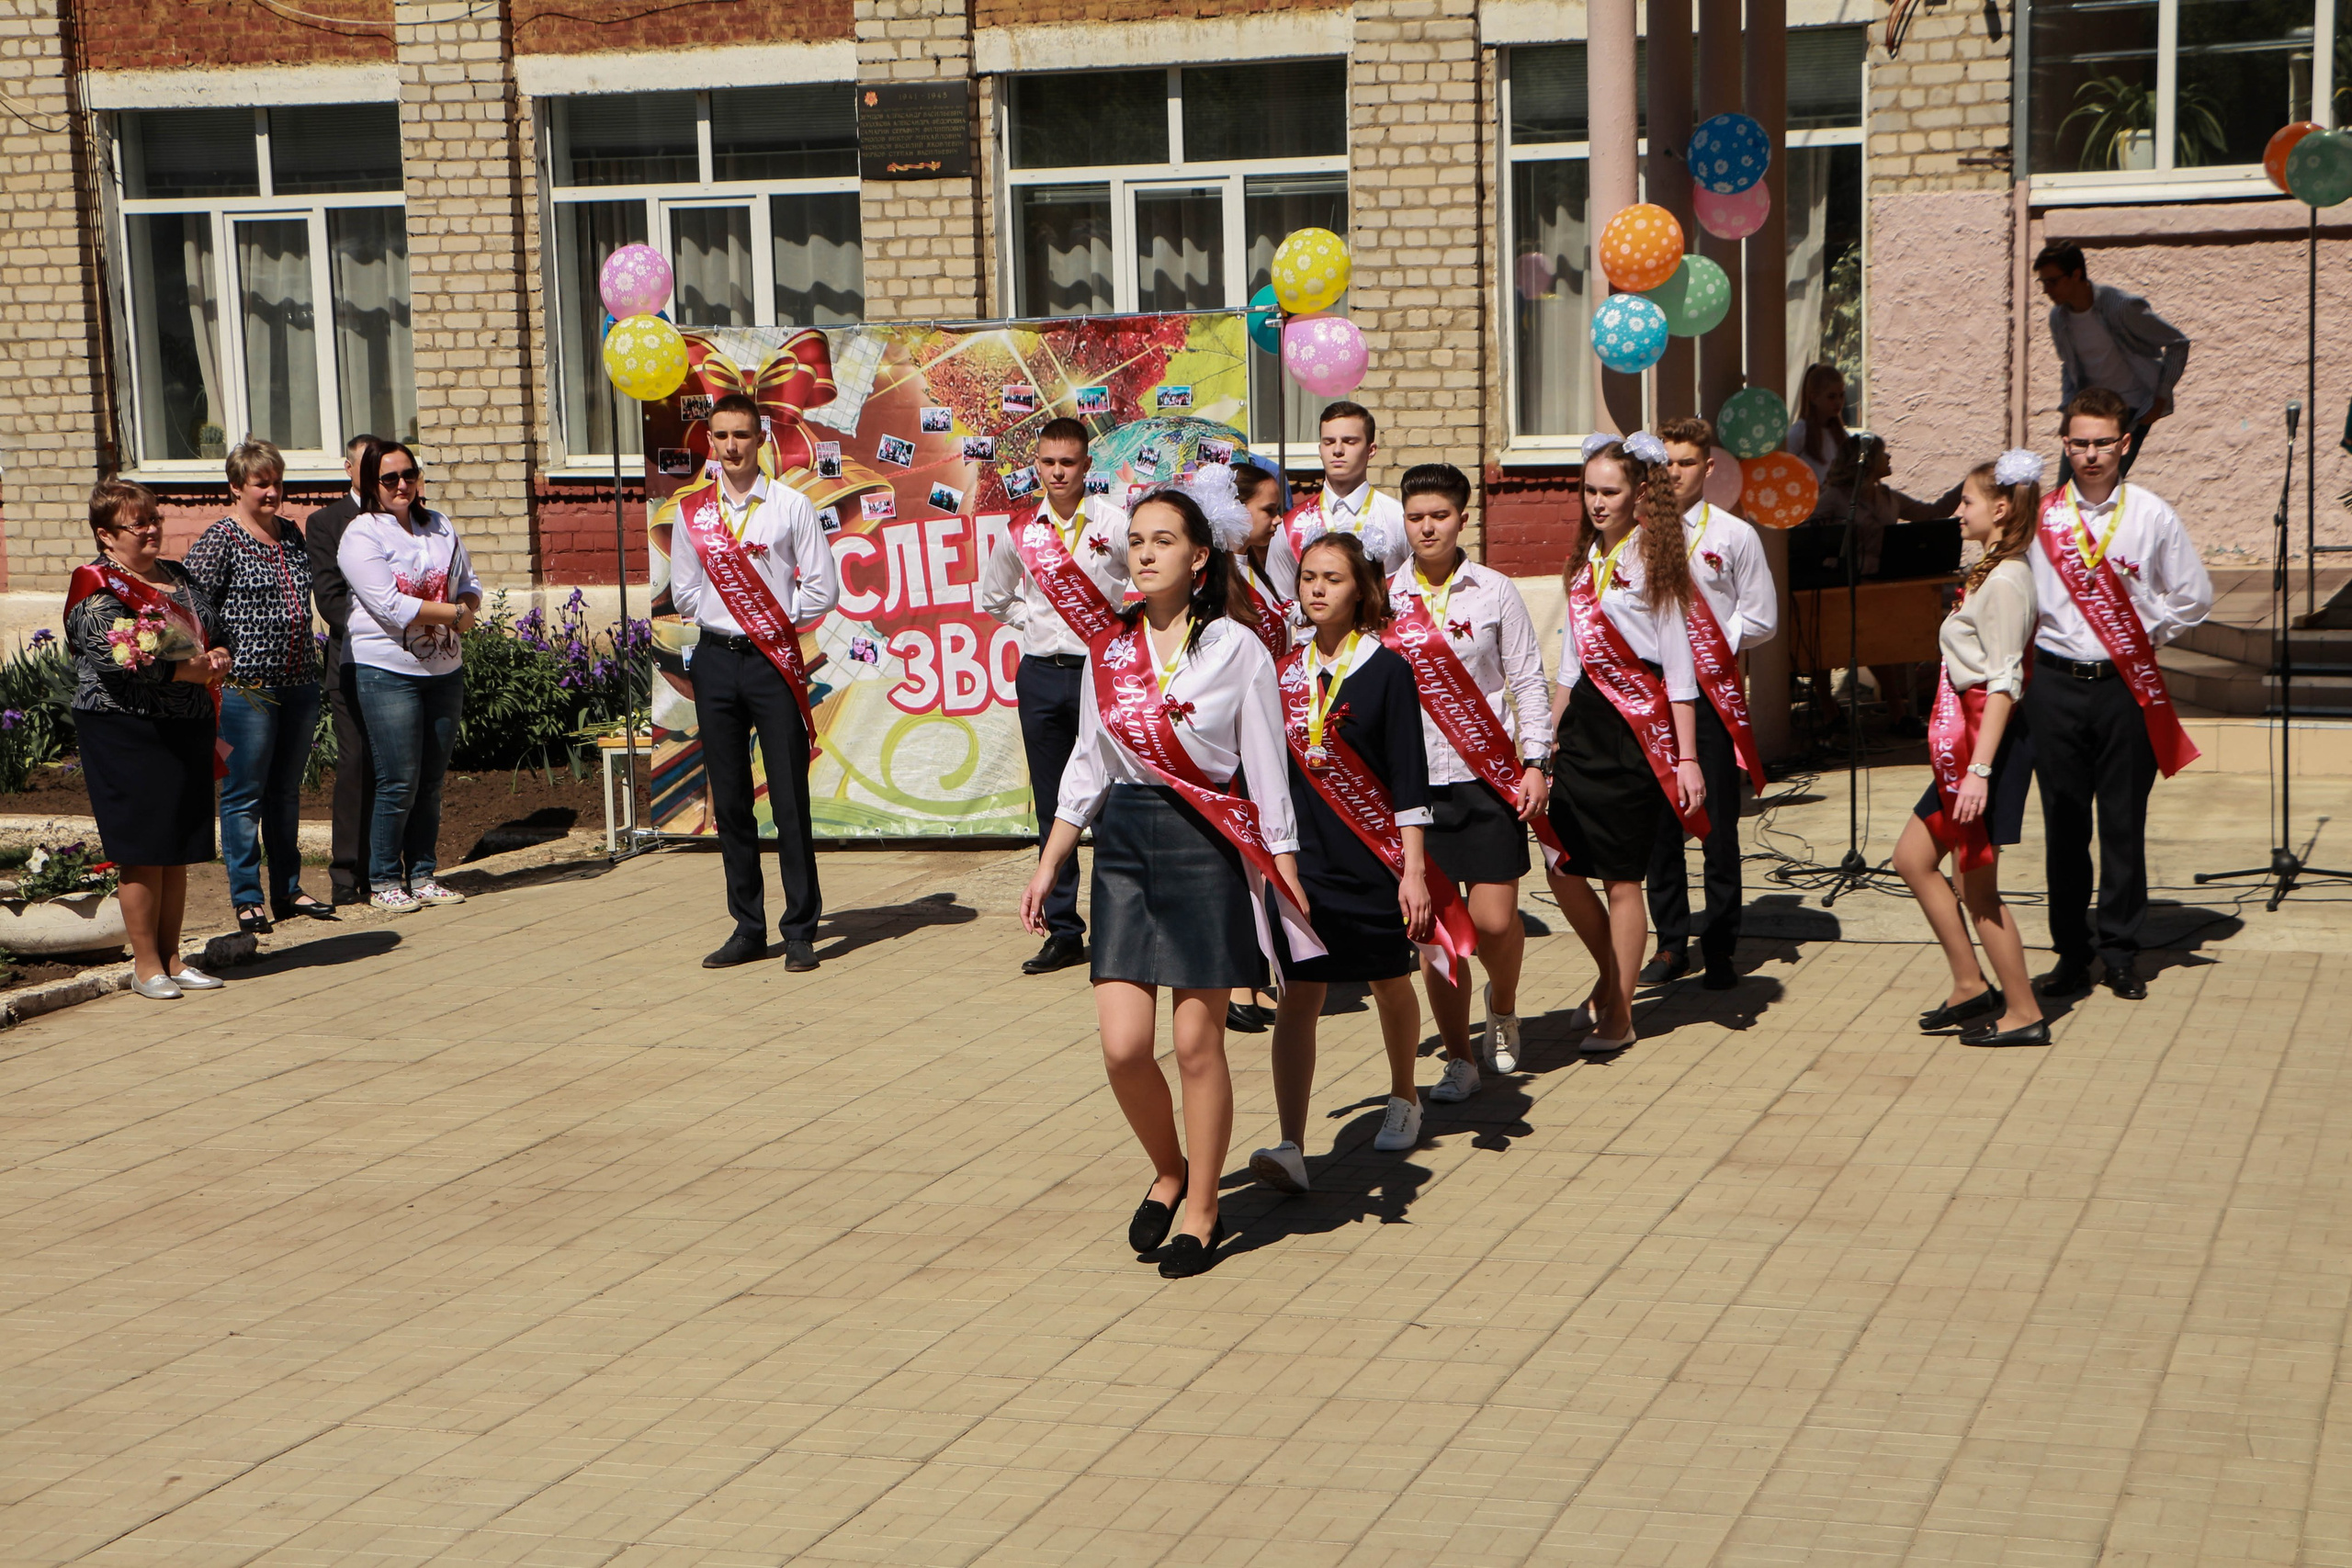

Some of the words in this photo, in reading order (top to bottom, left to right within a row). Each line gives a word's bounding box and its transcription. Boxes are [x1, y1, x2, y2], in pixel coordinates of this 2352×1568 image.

[887, 111, 921, 119] АЛЕКСАНДР
[922, 109, 964, 118] ВАСИЛЬЕВИЧ
[899, 93, 918, 101] 1941
[927, 91, 948, 100] 1945
[891, 126, 921, 134] СЕРАФИМ
[894, 141, 923, 149] ВАСИЛИЙ
[926, 140, 965, 148] ЯКОВЛЕВИЧ
[915, 132, 962, 141] МИХАЙЛОВИЧ
[917, 148, 958, 156] ВАСИЛЬЕВИЧ
[704, 532, 775, 640] Выпускник
[775, 642, 805, 684] 2021
[1066, 574, 1094, 607] Паршин
[752, 589, 786, 644] Константин
[1570, 593, 1655, 716] Выпускник
[1594, 622, 1626, 667] Ступина
[1627, 672, 1654, 698] Алина
[1396, 622, 1488, 751] Выпускник
[1430, 654, 1463, 694] Мысина
[1463, 699, 1494, 737] Валерия
[1717, 679, 1748, 727] 2021
[2133, 659, 2165, 705] 2021
[1142, 704, 1176, 771] Шашкина
[1939, 738, 1959, 795] 2021
[1365, 787, 1392, 820] Юлия
